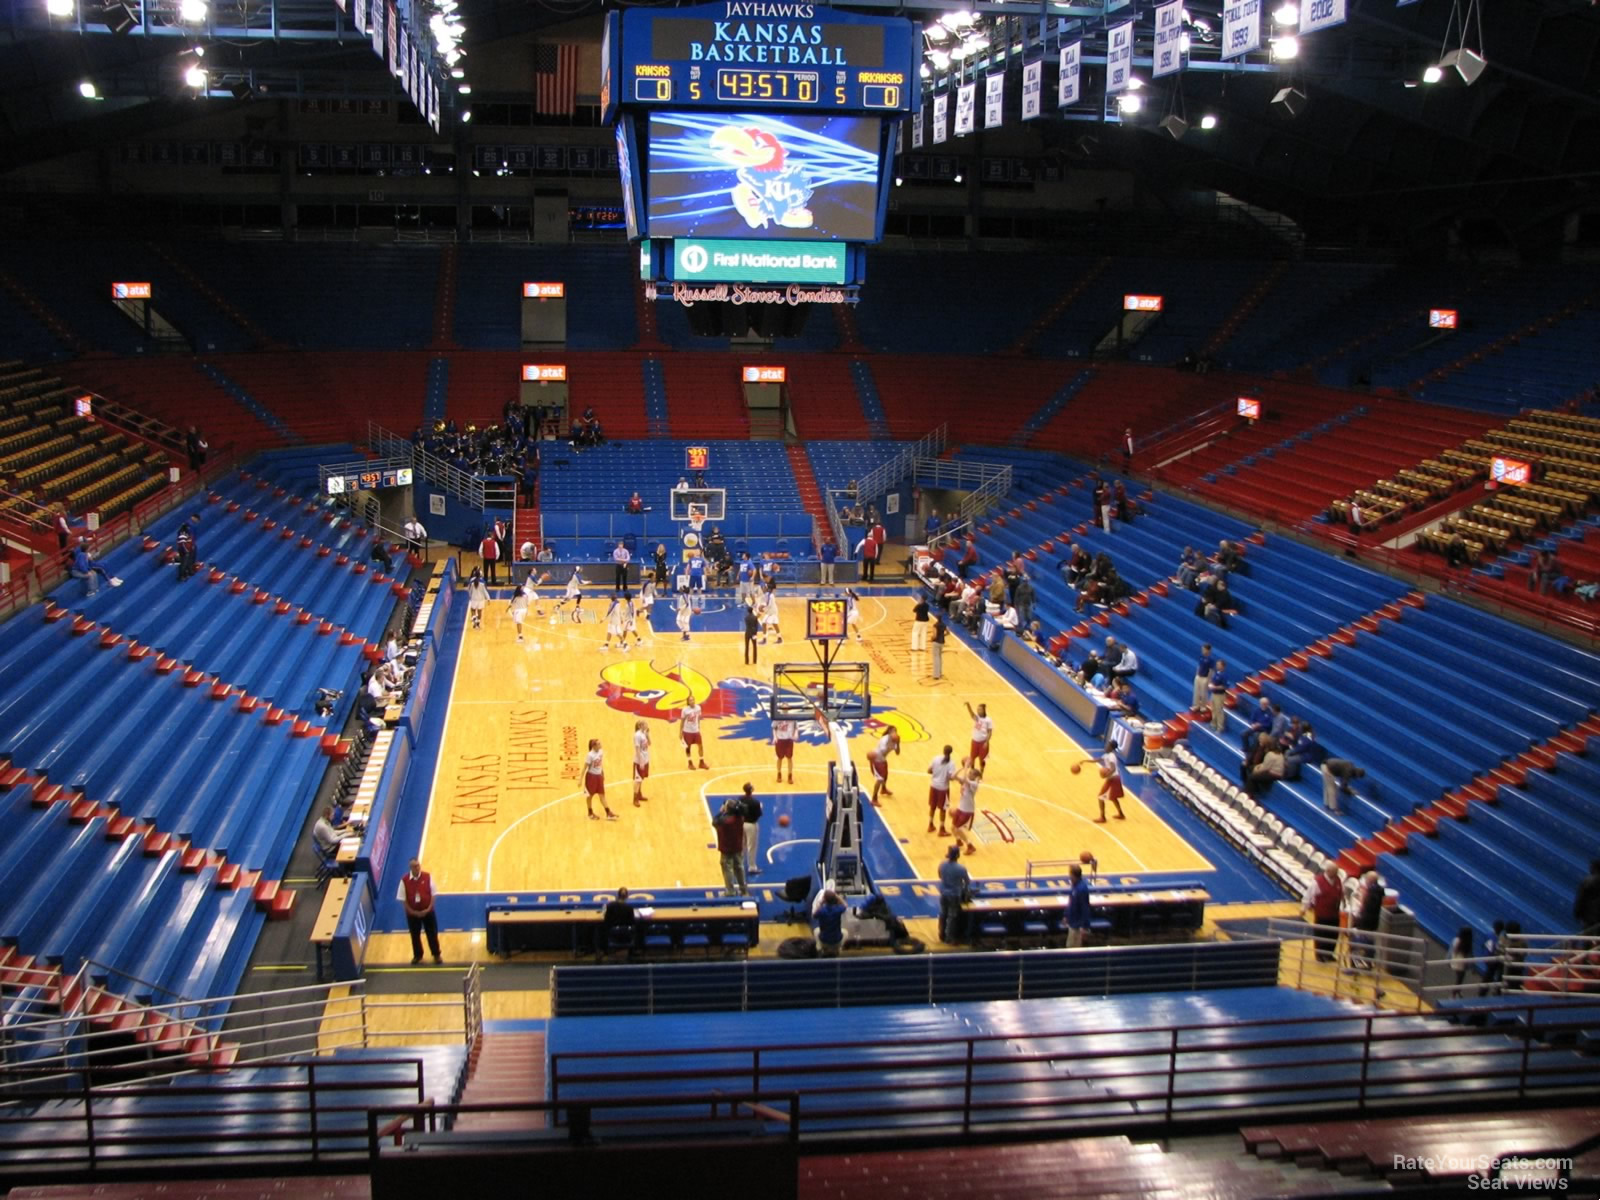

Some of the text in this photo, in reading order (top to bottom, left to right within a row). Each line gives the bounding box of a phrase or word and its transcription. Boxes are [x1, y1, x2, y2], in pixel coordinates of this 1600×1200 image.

[726, 2, 814, 19] JAYHAWKS
[714, 21, 822, 45] KANSAS
[691, 43, 846, 65] BASKETBALL
[635, 64, 670, 76] KANSAS
[859, 72, 903, 84] ARKANSAS
[656, 80, 669, 99] 0
[690, 83, 701, 100] 5
[723, 73, 787, 97] 43:57
[799, 82, 811, 100] 0
[835, 87, 846, 104] 5
[884, 87, 896, 105] 0
[765, 180, 791, 200] KU
[713, 252, 740, 267] First
[741, 252, 802, 268] National
[802, 254, 838, 269] Bank
[673, 282, 845, 307] Russell Stover Candies
[811, 602, 844, 613] 43:57
[1110, 719, 1128, 751] KU
[506, 710, 560, 791] JAYHAWKS
[451, 754, 502, 825] KANSAS
